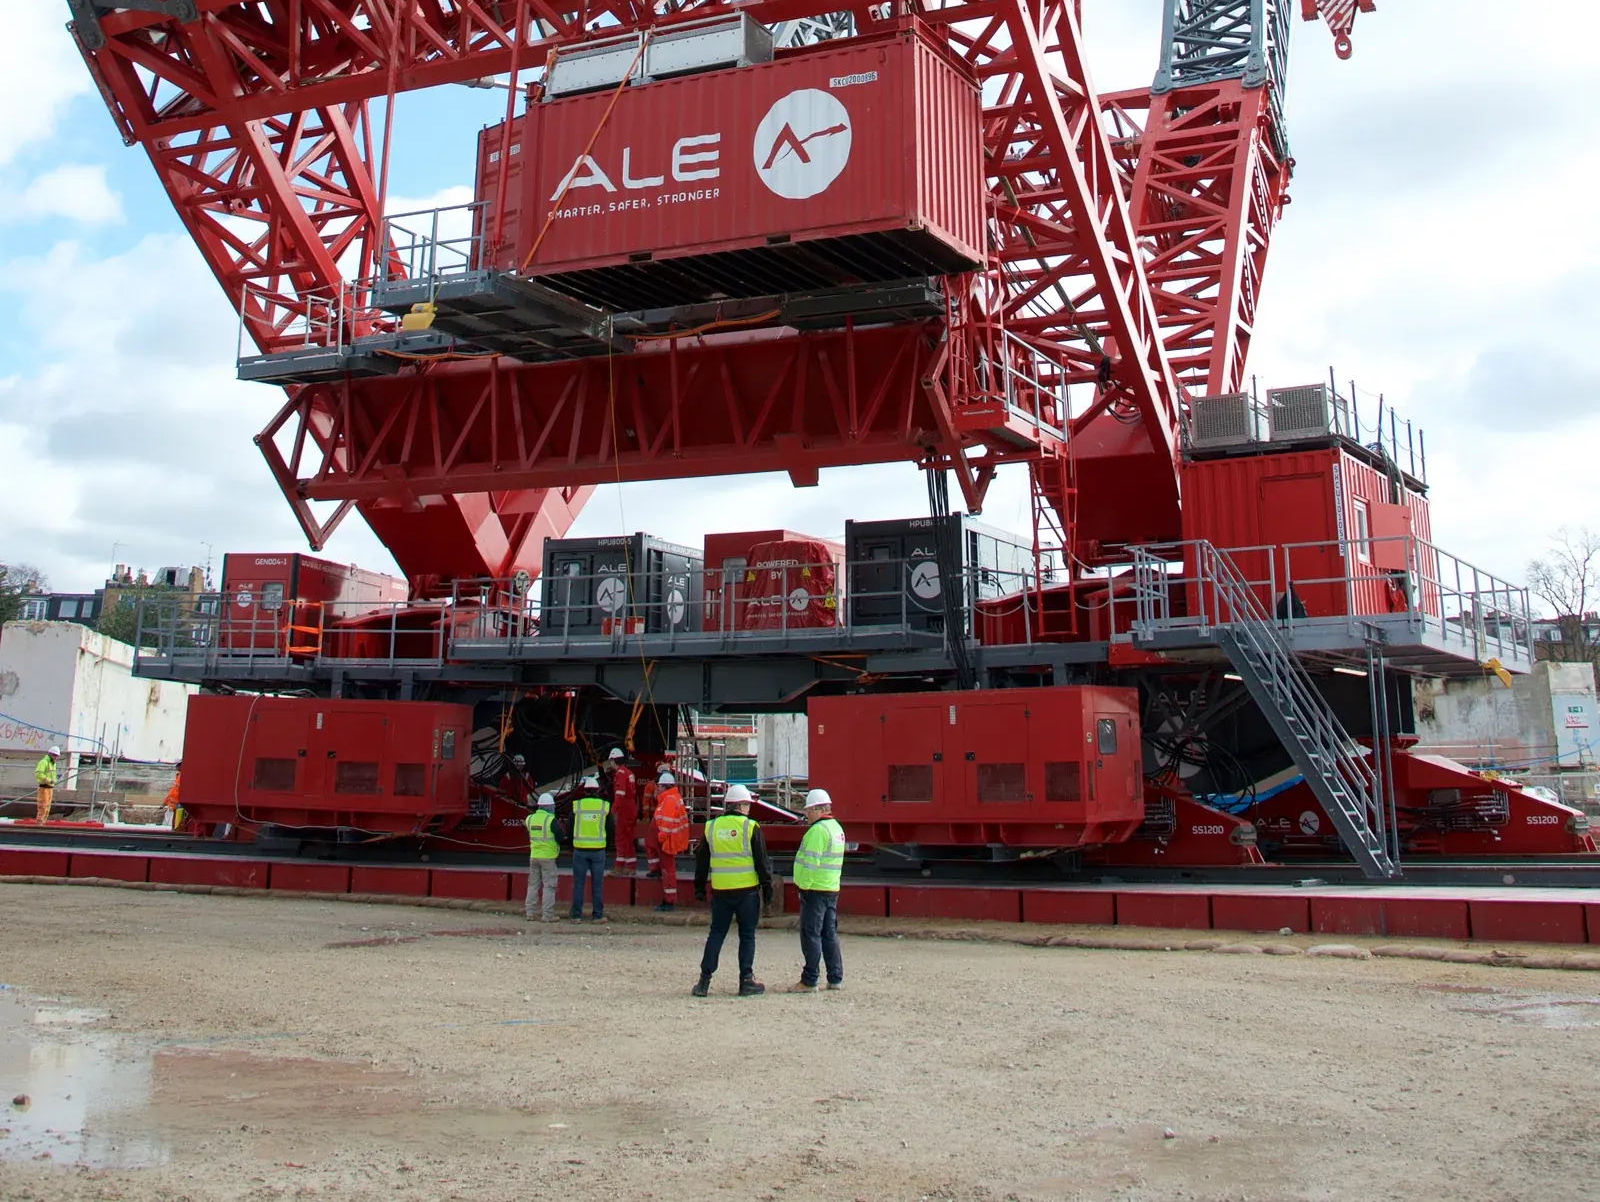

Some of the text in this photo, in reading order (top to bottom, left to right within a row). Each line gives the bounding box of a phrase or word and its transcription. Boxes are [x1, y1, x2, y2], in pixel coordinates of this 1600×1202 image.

[549, 132, 721, 202] ALE
[547, 188, 720, 221] SMARTER, SAFER, STRONGER
[911, 547, 937, 557] AL
[597, 563, 628, 573] ALE
[756, 559, 799, 568] POWERED
[770, 571, 783, 580] BY
[747, 594, 782, 608] ALE
[1256, 817, 1291, 828] ALE
[1525, 815, 1559, 825] SS1200
[1191, 825, 1225, 835] SS1200
